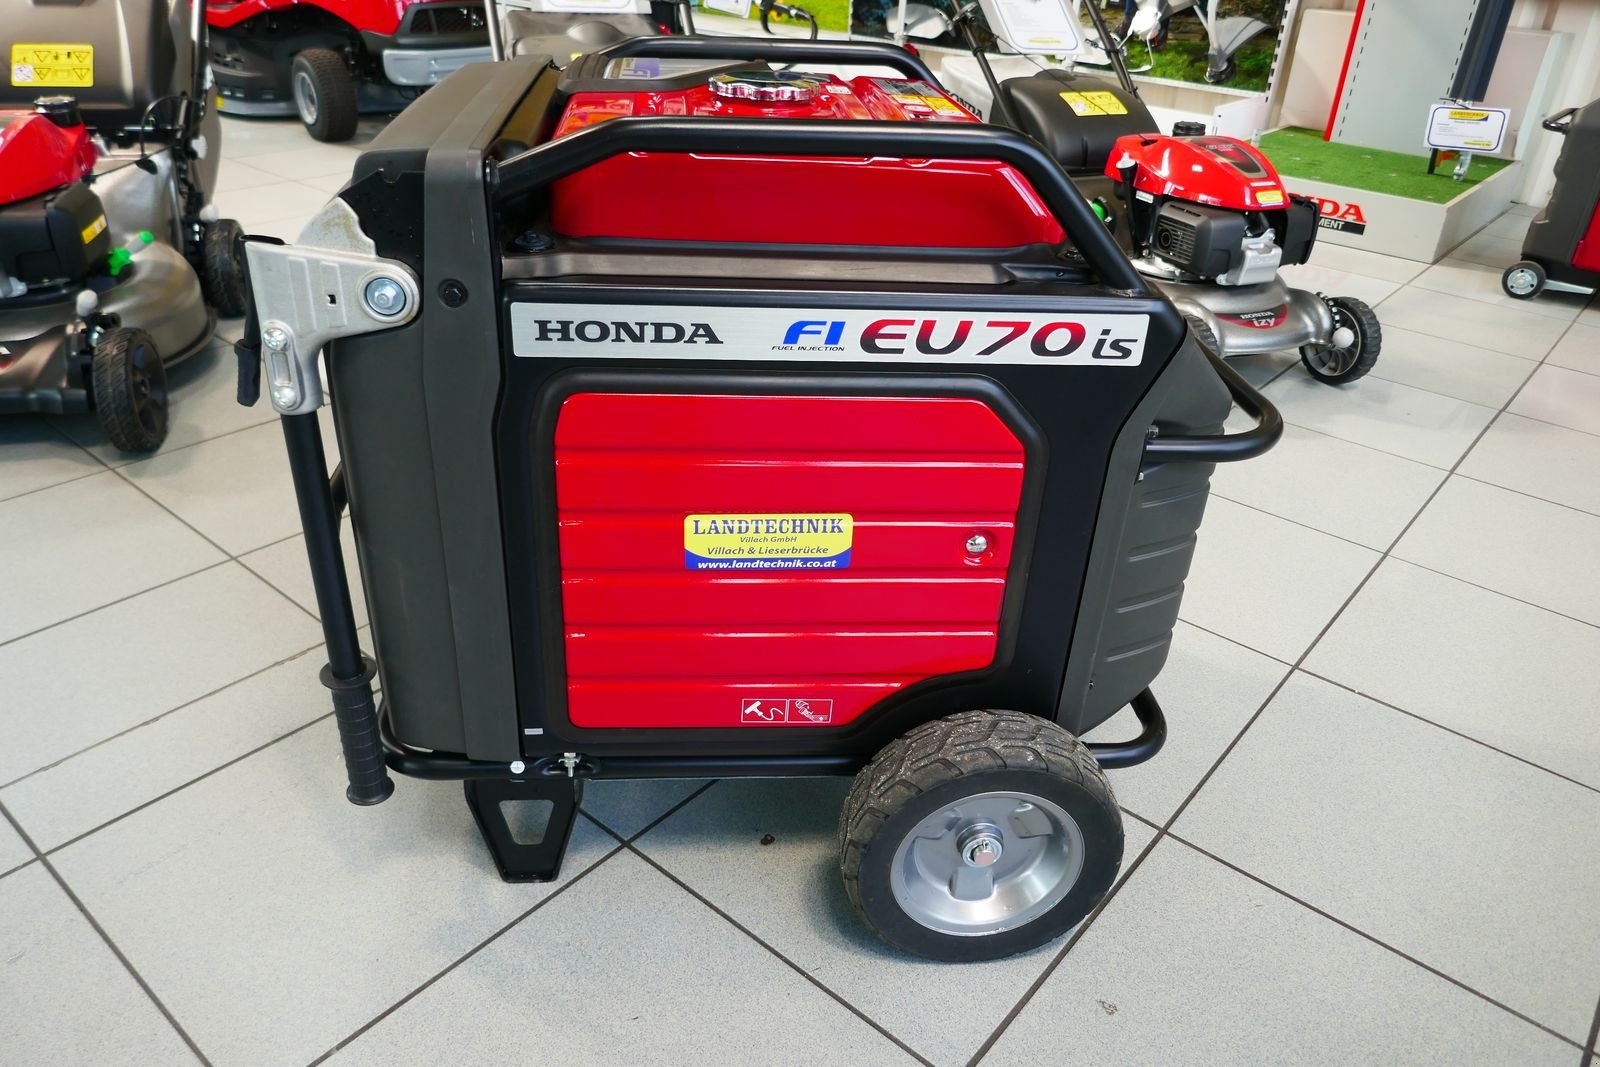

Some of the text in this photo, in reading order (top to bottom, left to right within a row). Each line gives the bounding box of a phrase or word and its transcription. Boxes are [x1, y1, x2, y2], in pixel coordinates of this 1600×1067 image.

[1240, 311, 1275, 320] HONDA
[533, 319, 724, 345] HONDA
[782, 320, 847, 346] FI
[692, 517, 845, 536] LANDTECHNIK
[740, 535, 798, 543] Villach GmbH
[706, 545, 829, 556] Villach & Lieserbrücke
[698, 559, 837, 569] www.landtechnik.co.at
